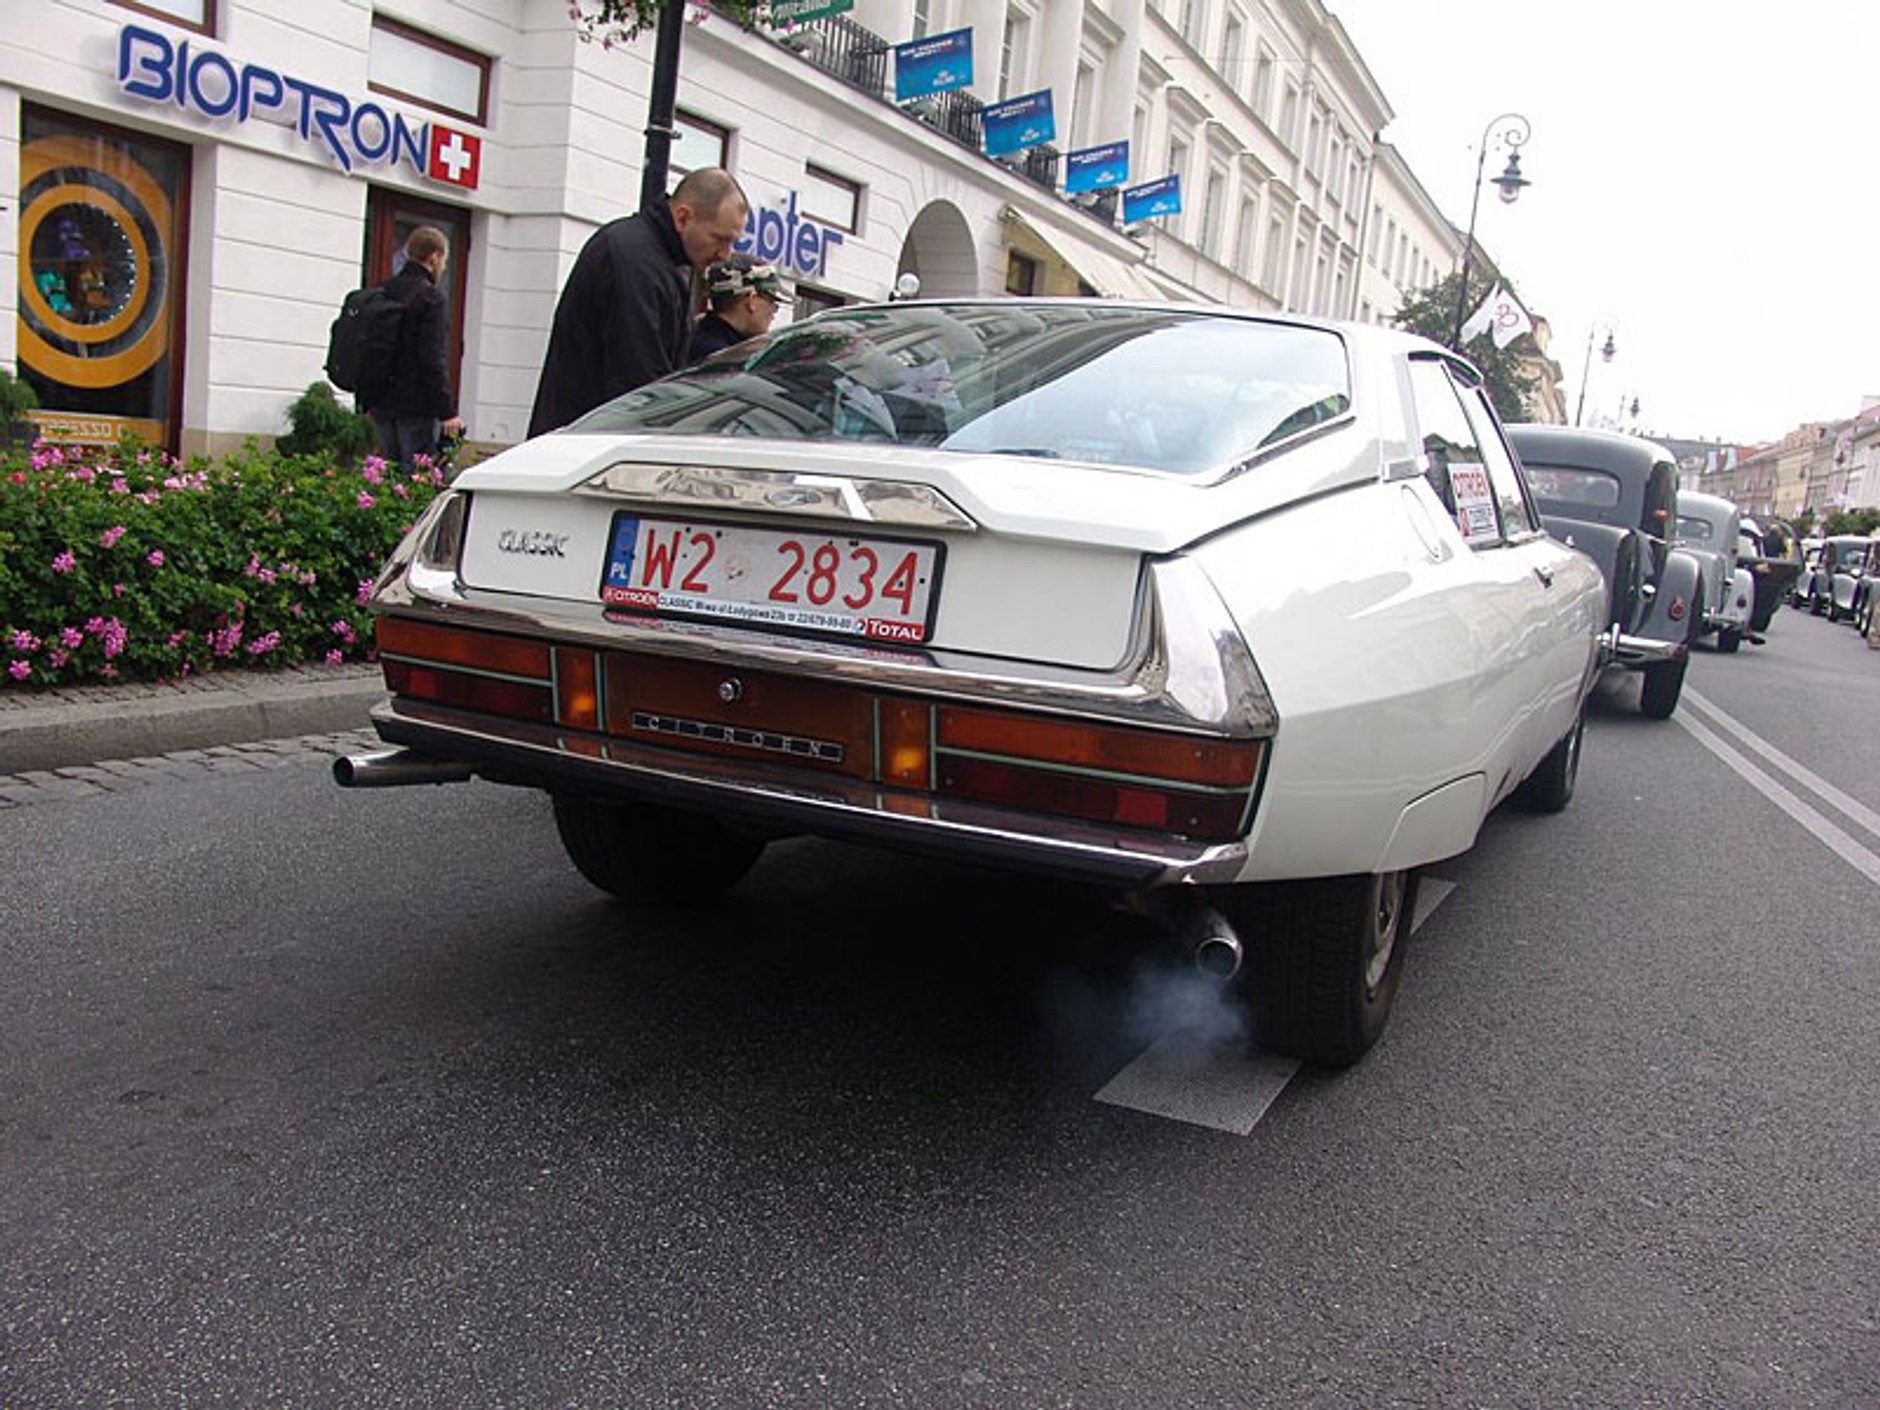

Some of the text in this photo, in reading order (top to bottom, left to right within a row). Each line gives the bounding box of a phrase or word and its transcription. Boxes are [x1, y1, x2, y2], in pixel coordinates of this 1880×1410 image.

[118, 23, 430, 172] BIOPTRON
[610, 561, 628, 580] PL
[641, 528, 919, 616] W2 2834
[869, 619, 924, 641] TOTAL
